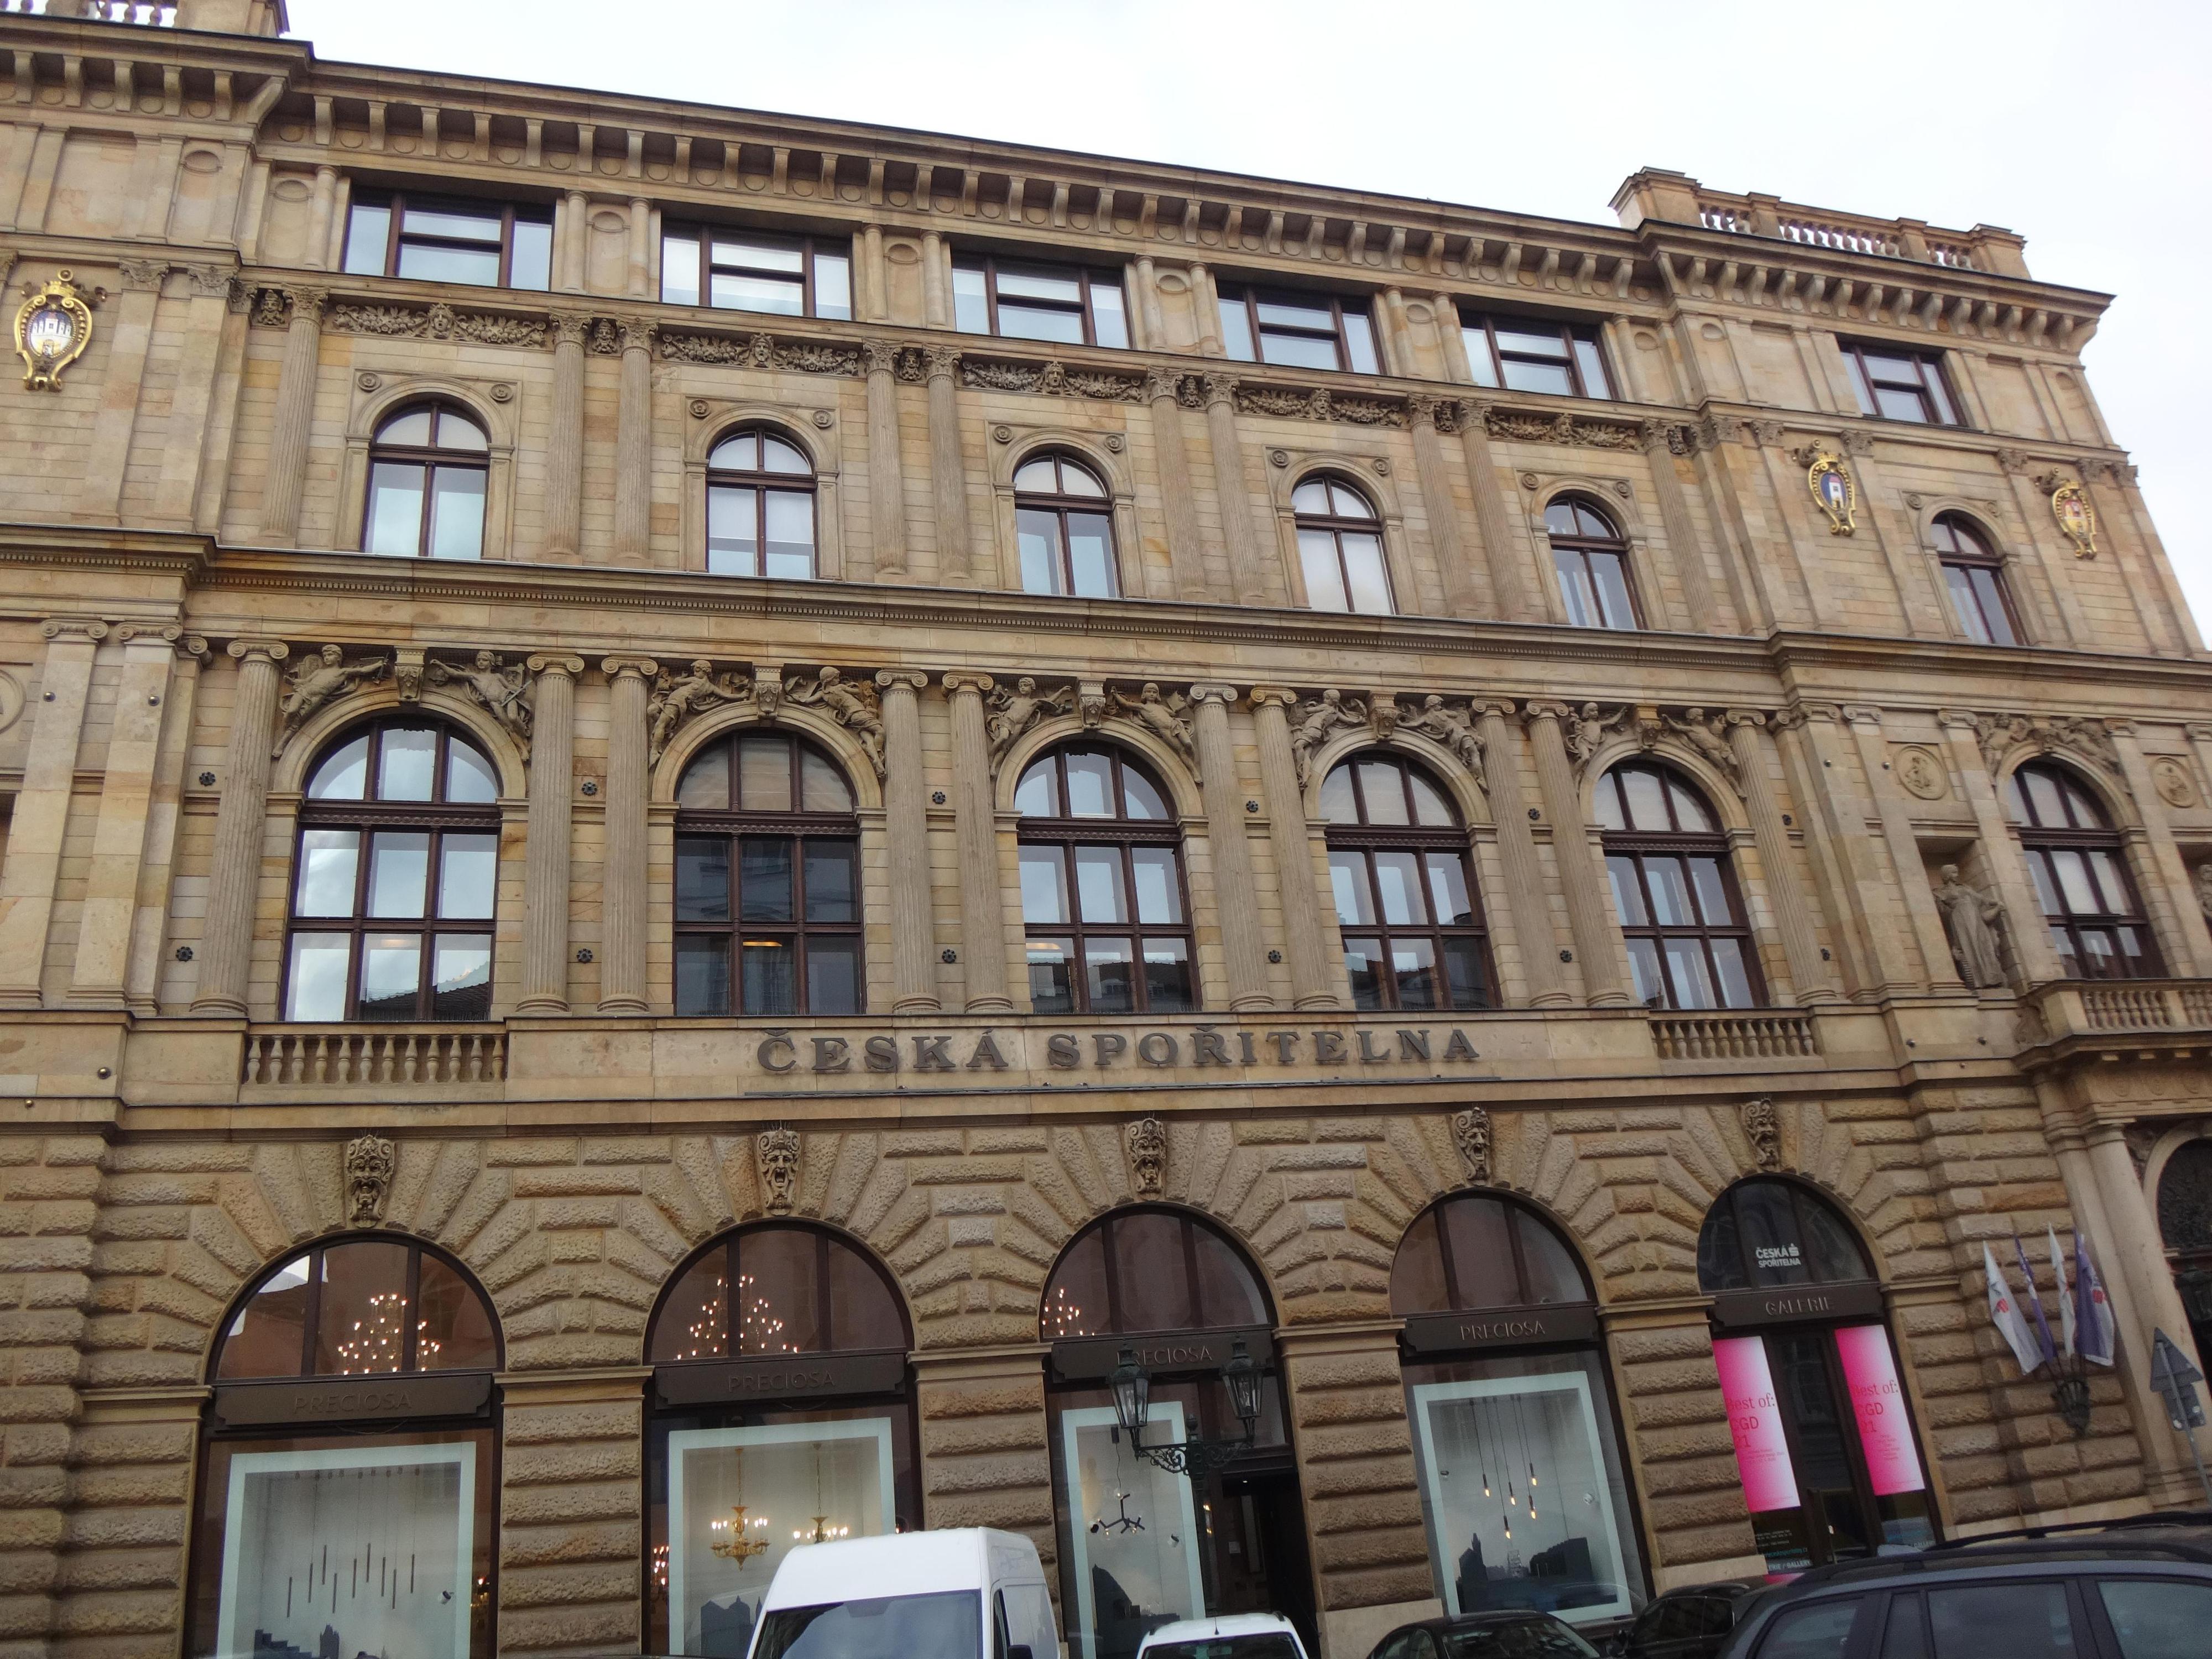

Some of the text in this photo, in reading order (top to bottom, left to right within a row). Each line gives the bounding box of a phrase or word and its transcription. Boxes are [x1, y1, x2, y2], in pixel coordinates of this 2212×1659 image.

[757, 1025, 1480, 1072] ČESKÁ SPOŘITELNA
[1755, 1245, 1790, 1259] ČESKÁ
[1758, 1257, 1801, 1268] SPOŘITELNA
[1765, 1296, 1833, 1316] GALERIE
[1460, 1320, 1546, 1340] PRECIOSA
[1117, 1345, 1213, 1366] RECIOSA
[728, 1370, 836, 1393] PRECIOSA
[294, 1392, 412, 1414] PRECIOSA
[1759, 1392, 1776, 1408] of:
